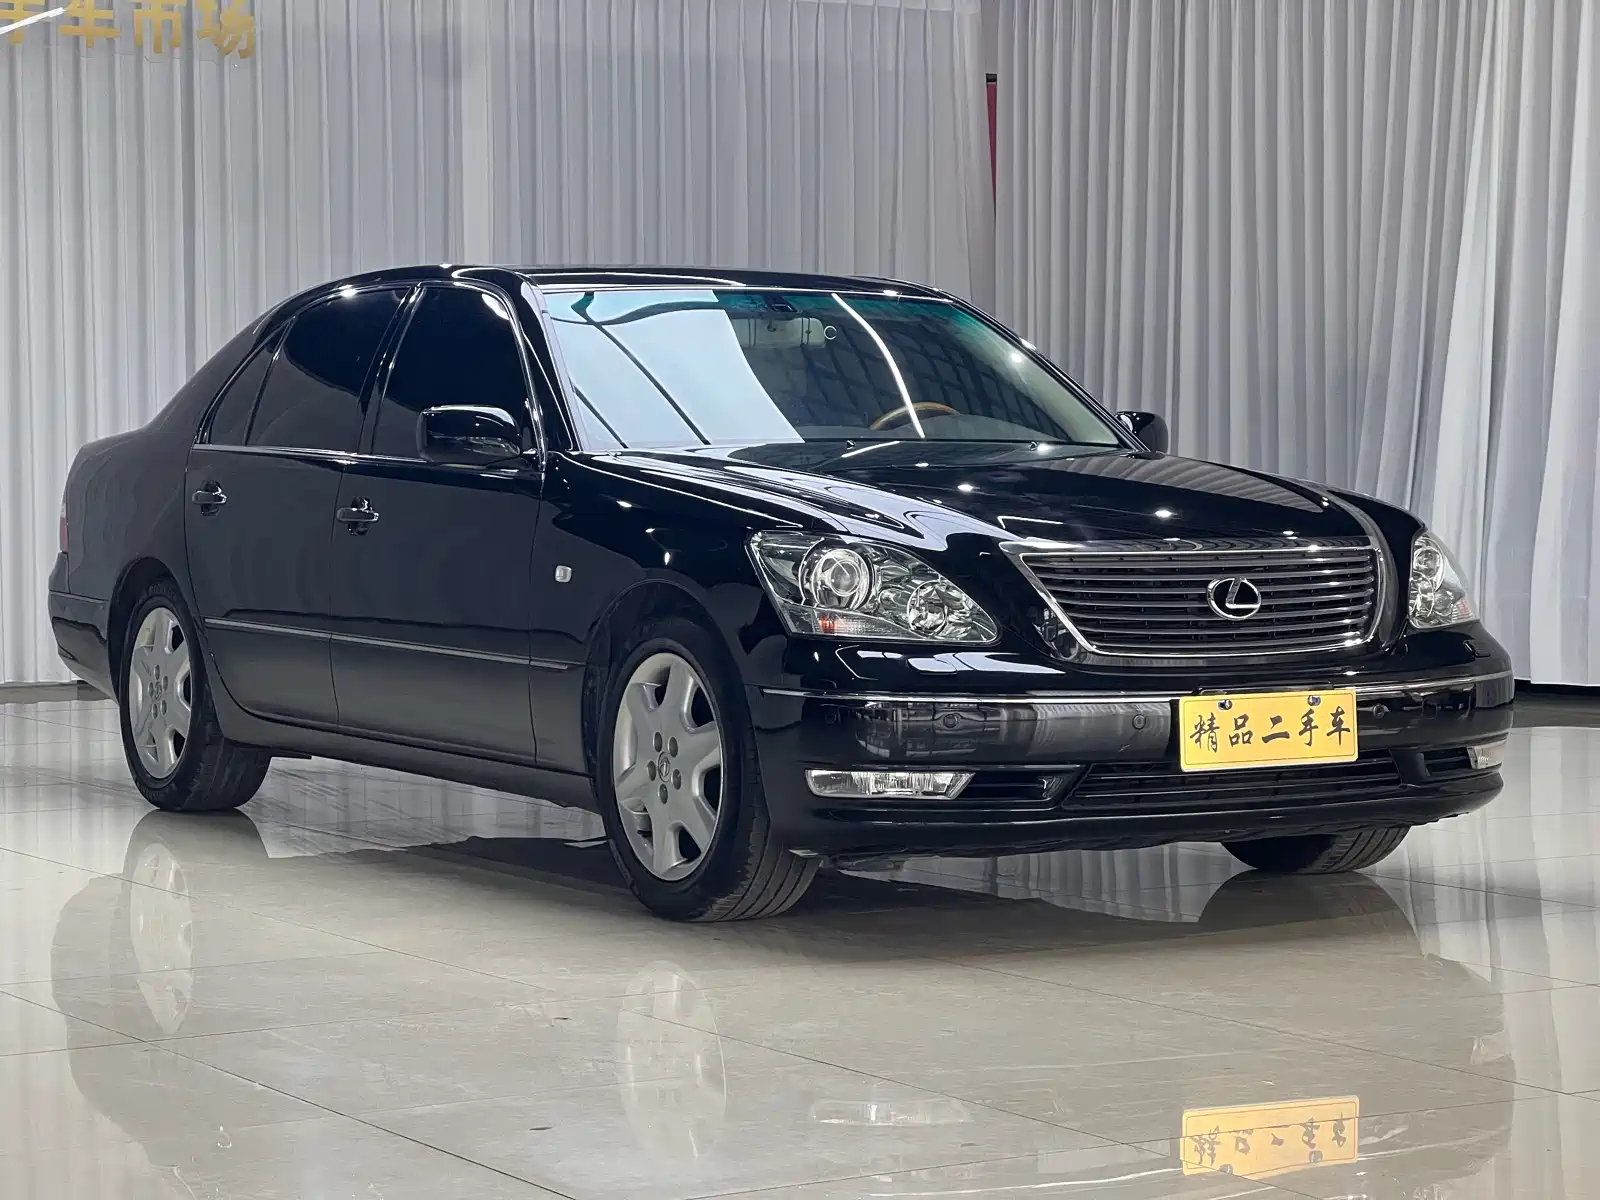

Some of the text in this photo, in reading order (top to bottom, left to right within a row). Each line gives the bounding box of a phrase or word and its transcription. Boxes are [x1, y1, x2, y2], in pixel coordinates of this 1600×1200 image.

[1189, 705, 1351, 753] 精品二手车
